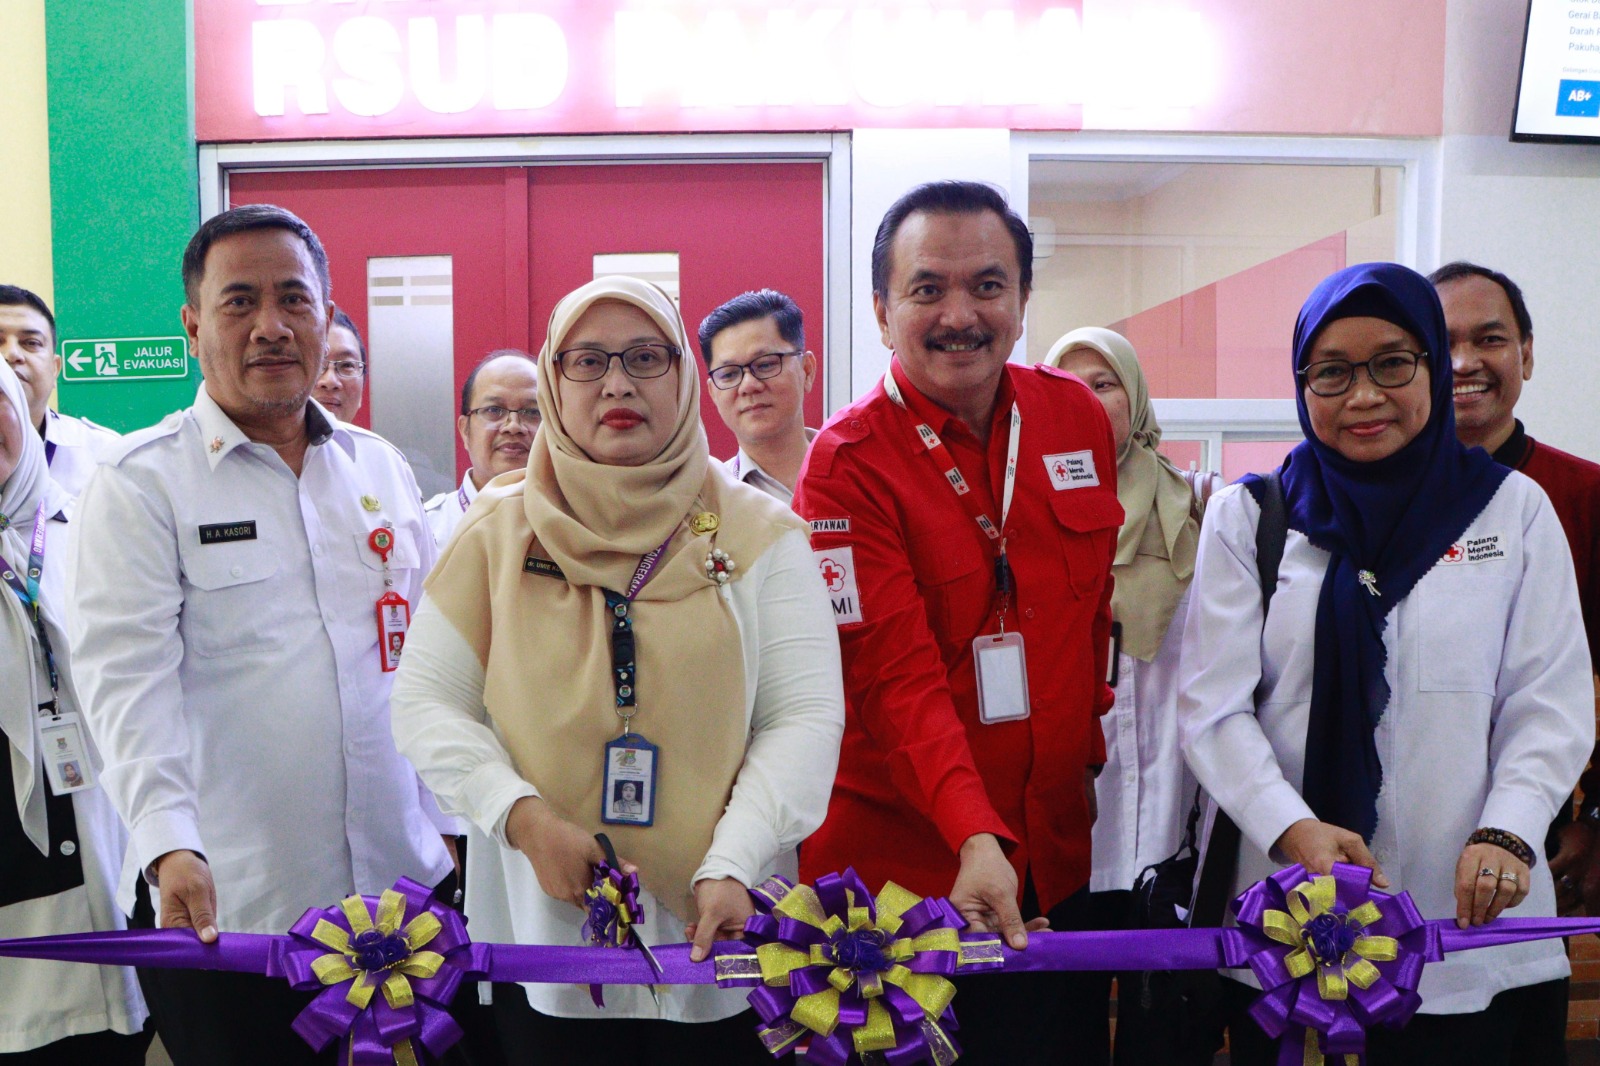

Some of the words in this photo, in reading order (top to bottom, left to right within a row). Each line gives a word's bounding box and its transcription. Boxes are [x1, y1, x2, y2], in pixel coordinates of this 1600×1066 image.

[1568, 10, 1591, 19] Gerai
[1569, 26, 1594, 35] Darah
[1568, 42, 1600, 54] Pakuha
[253, 13, 568, 115] RSUD
[615, 8, 1202, 107] PAKUHA
[1568, 89, 1592, 102] AB+
[133, 346, 173, 358] JALUR
[123, 358, 184, 370] EVAKUASI
[223, 526, 251, 537] KASORI
[1466, 535, 1498, 547] Palang
[1467, 543, 1496, 554] Merah
[1468, 550, 1504, 561] Indonesia
[831, 596, 853, 616] MI
